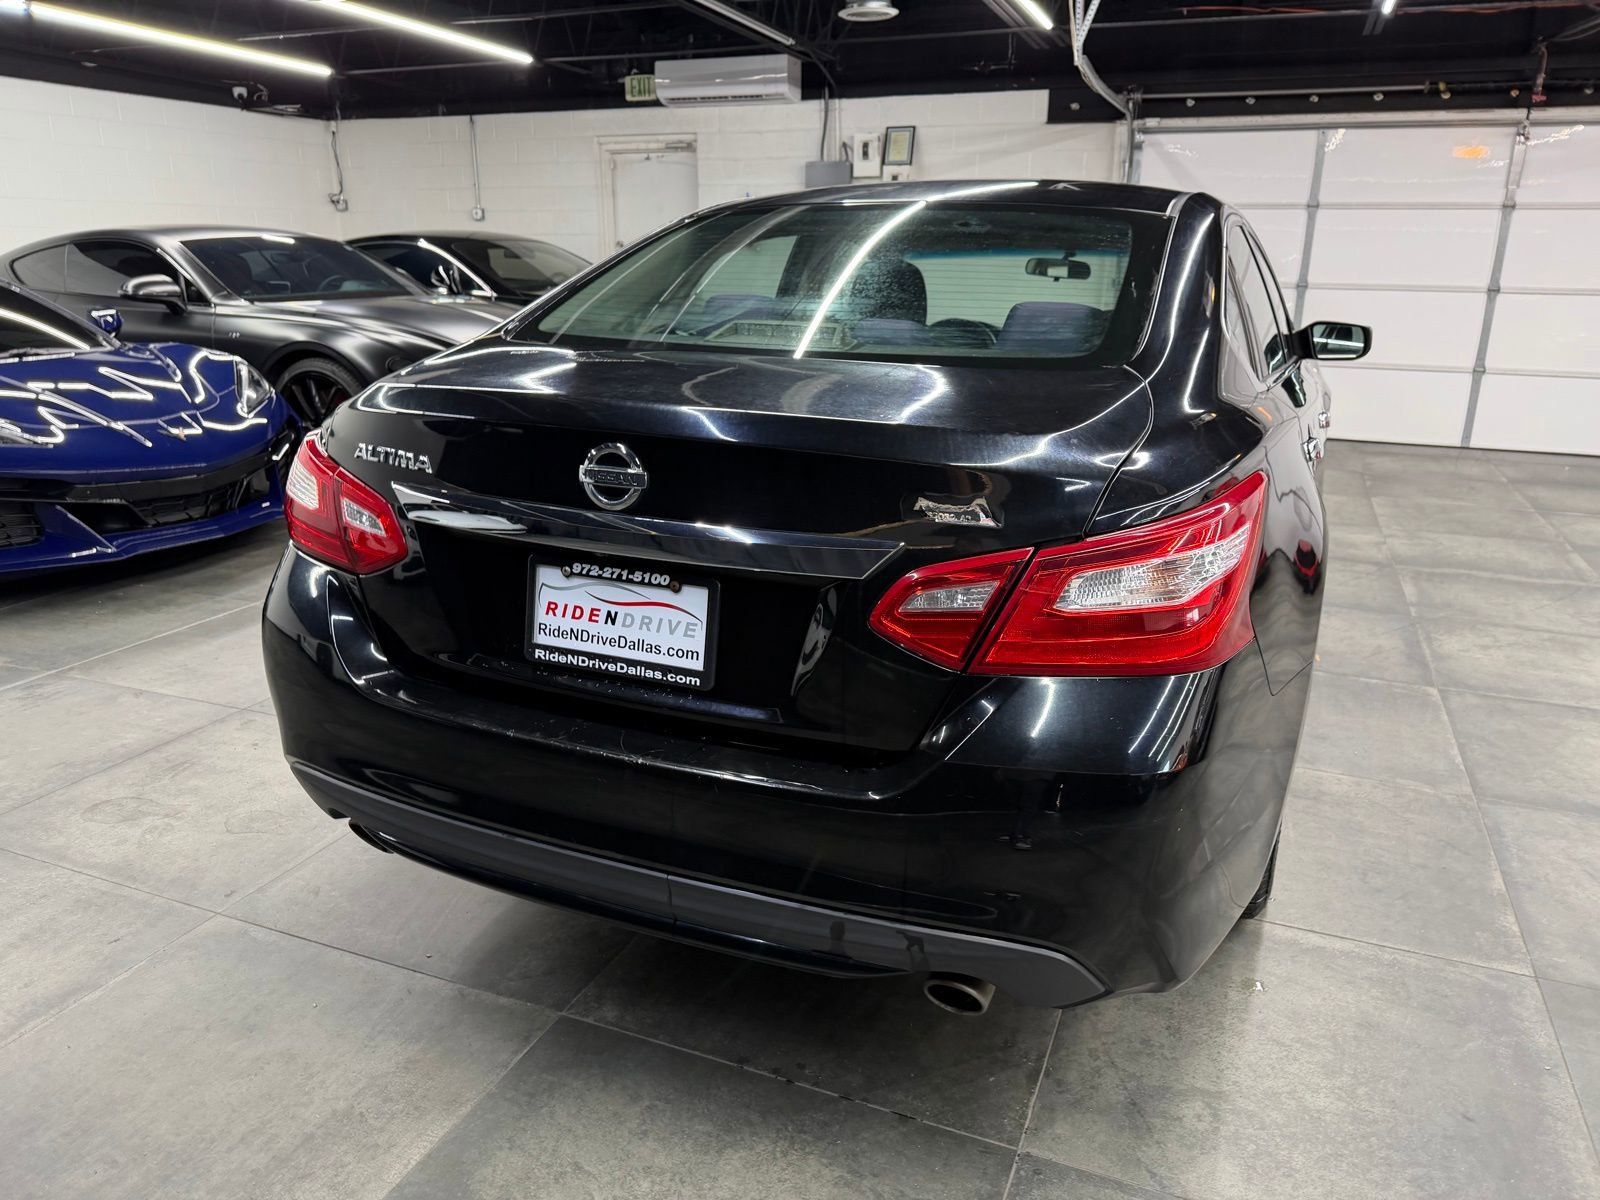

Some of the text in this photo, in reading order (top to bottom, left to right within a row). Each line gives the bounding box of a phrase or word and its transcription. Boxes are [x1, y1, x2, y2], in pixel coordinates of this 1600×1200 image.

[630, 77, 651, 97] EXIT
[354, 442, 433, 474] ALTIMA
[572, 563, 670, 586] 972-271-5100
[538, 622, 699, 661] RideNDriveDallas.com
[534, 649, 700, 686] RideNDriveDallas.com
